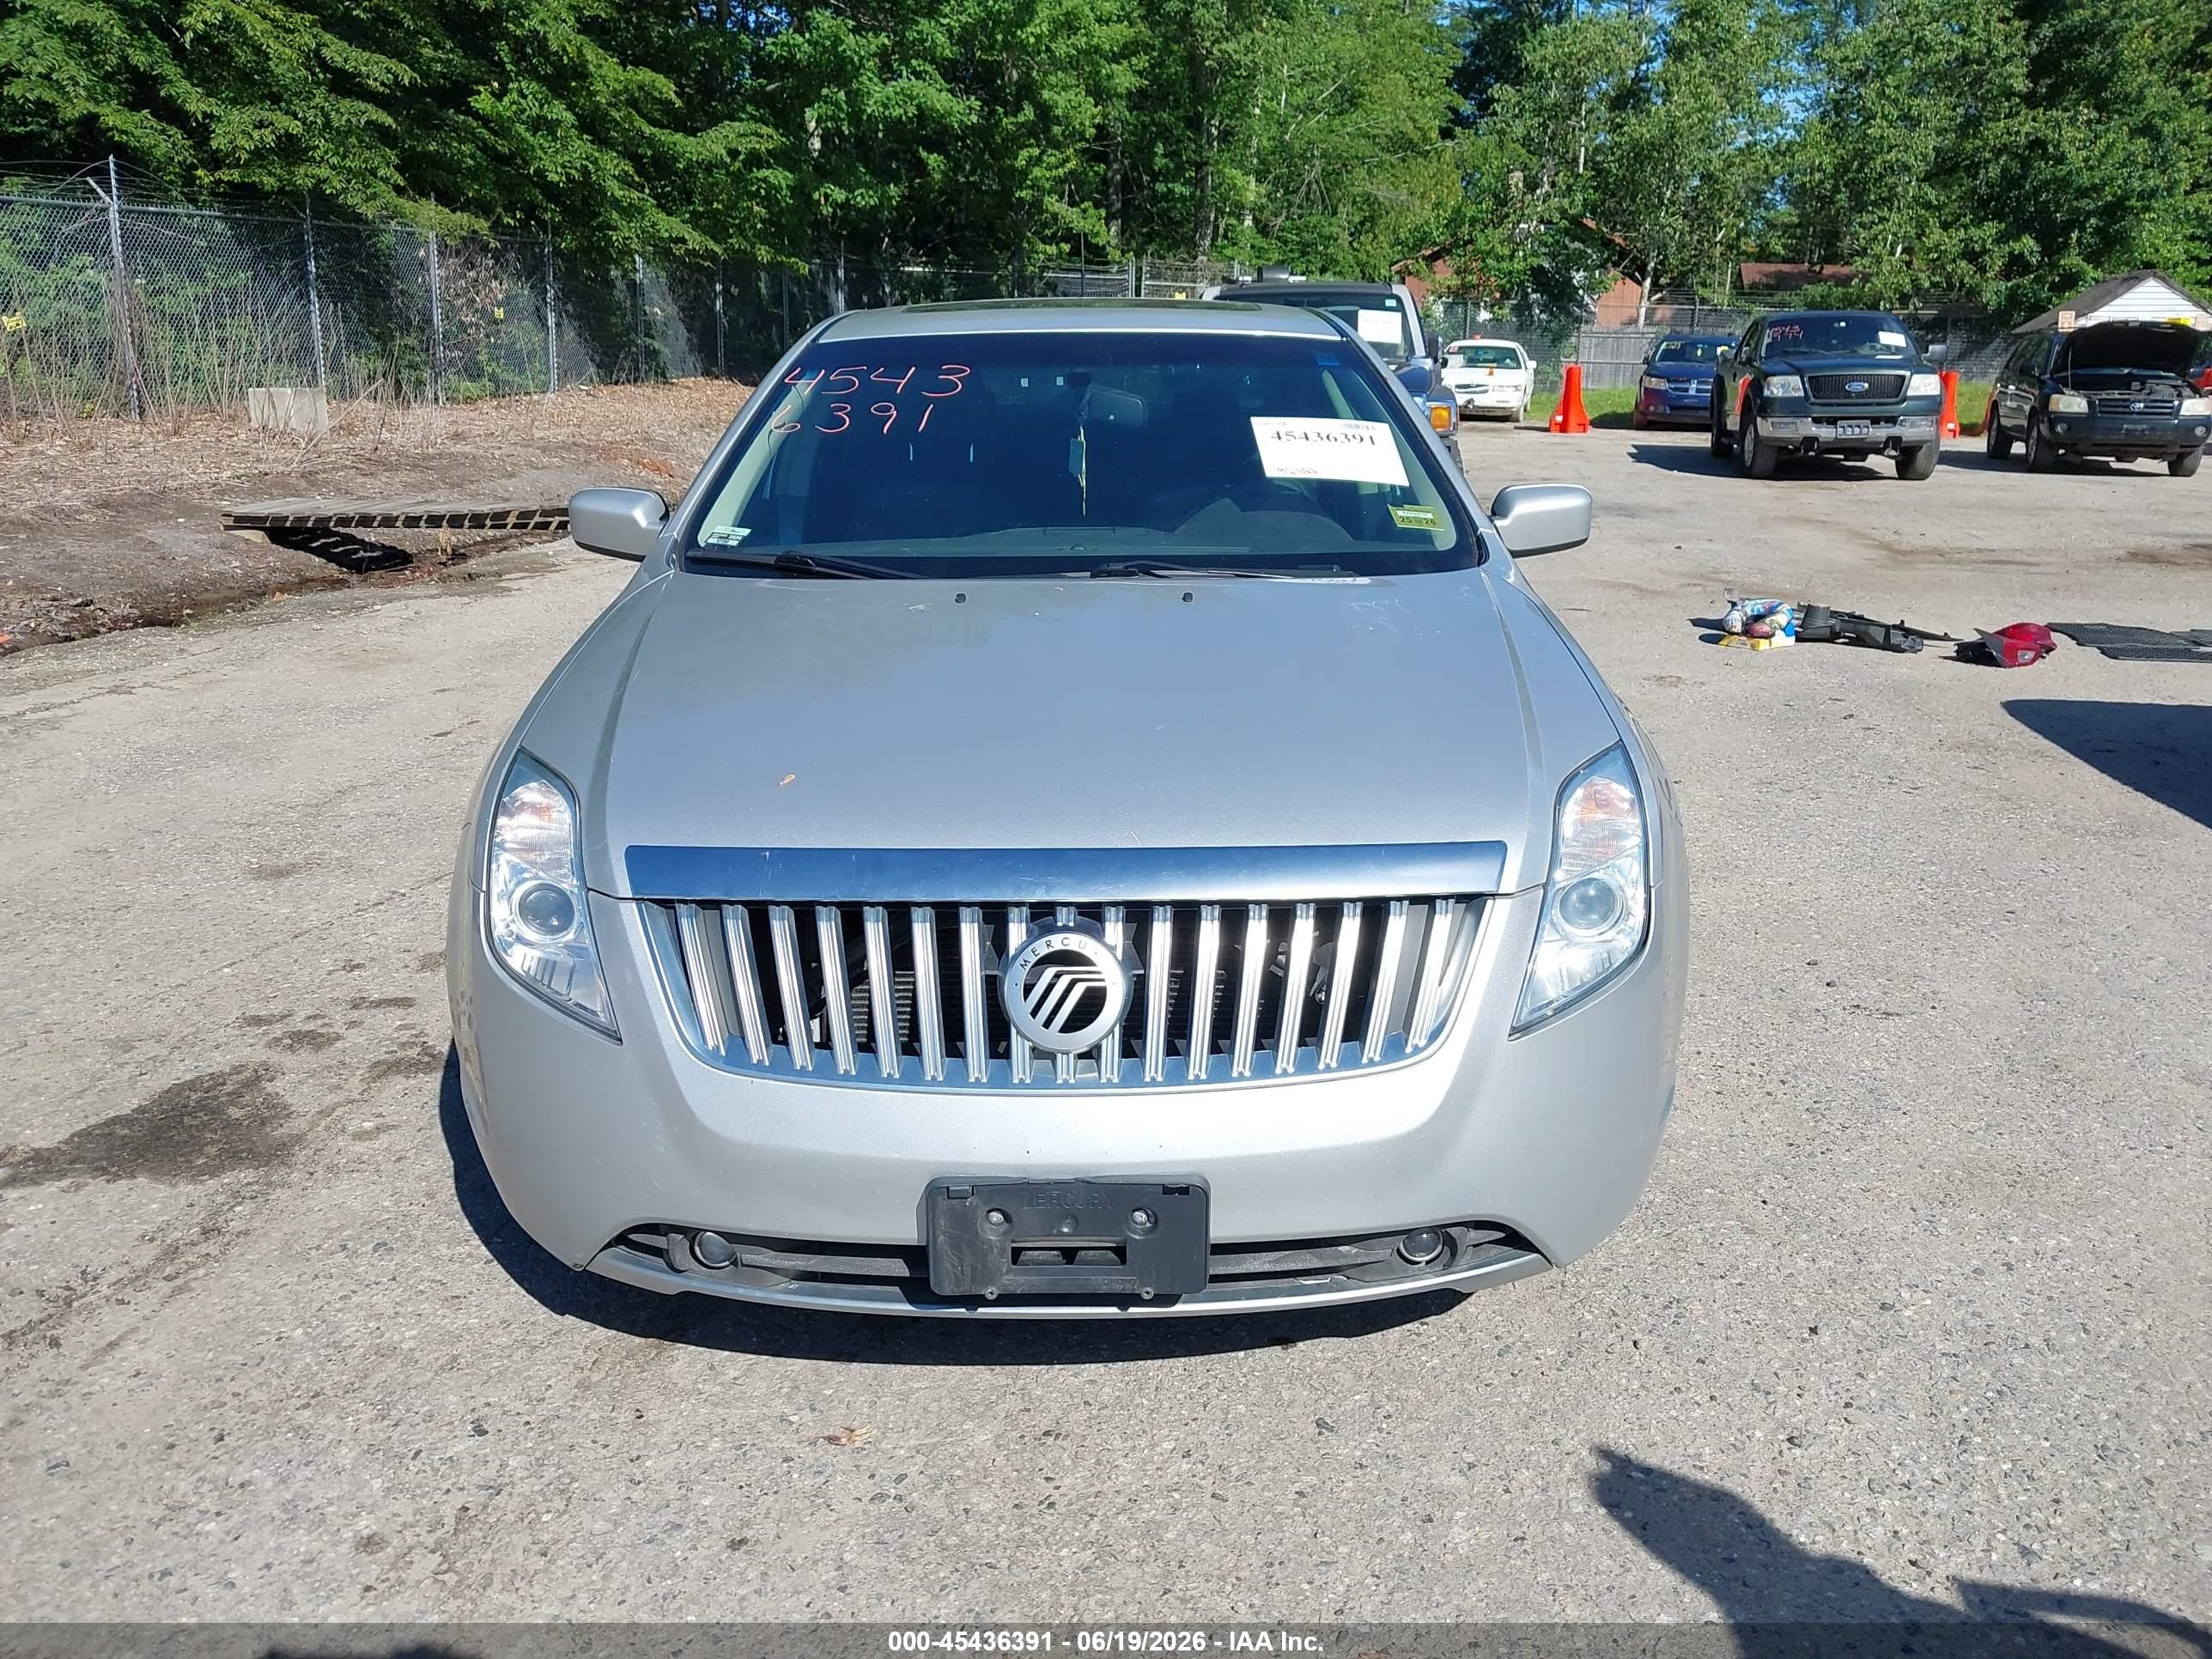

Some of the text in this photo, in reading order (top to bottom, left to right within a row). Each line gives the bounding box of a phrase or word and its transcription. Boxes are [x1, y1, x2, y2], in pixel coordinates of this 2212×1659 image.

[784, 365, 971, 397] 4543
[771, 402, 934, 434] 6391
[1270, 430, 1376, 446] 45436391
[1018, 937, 1103, 971] MERCU
